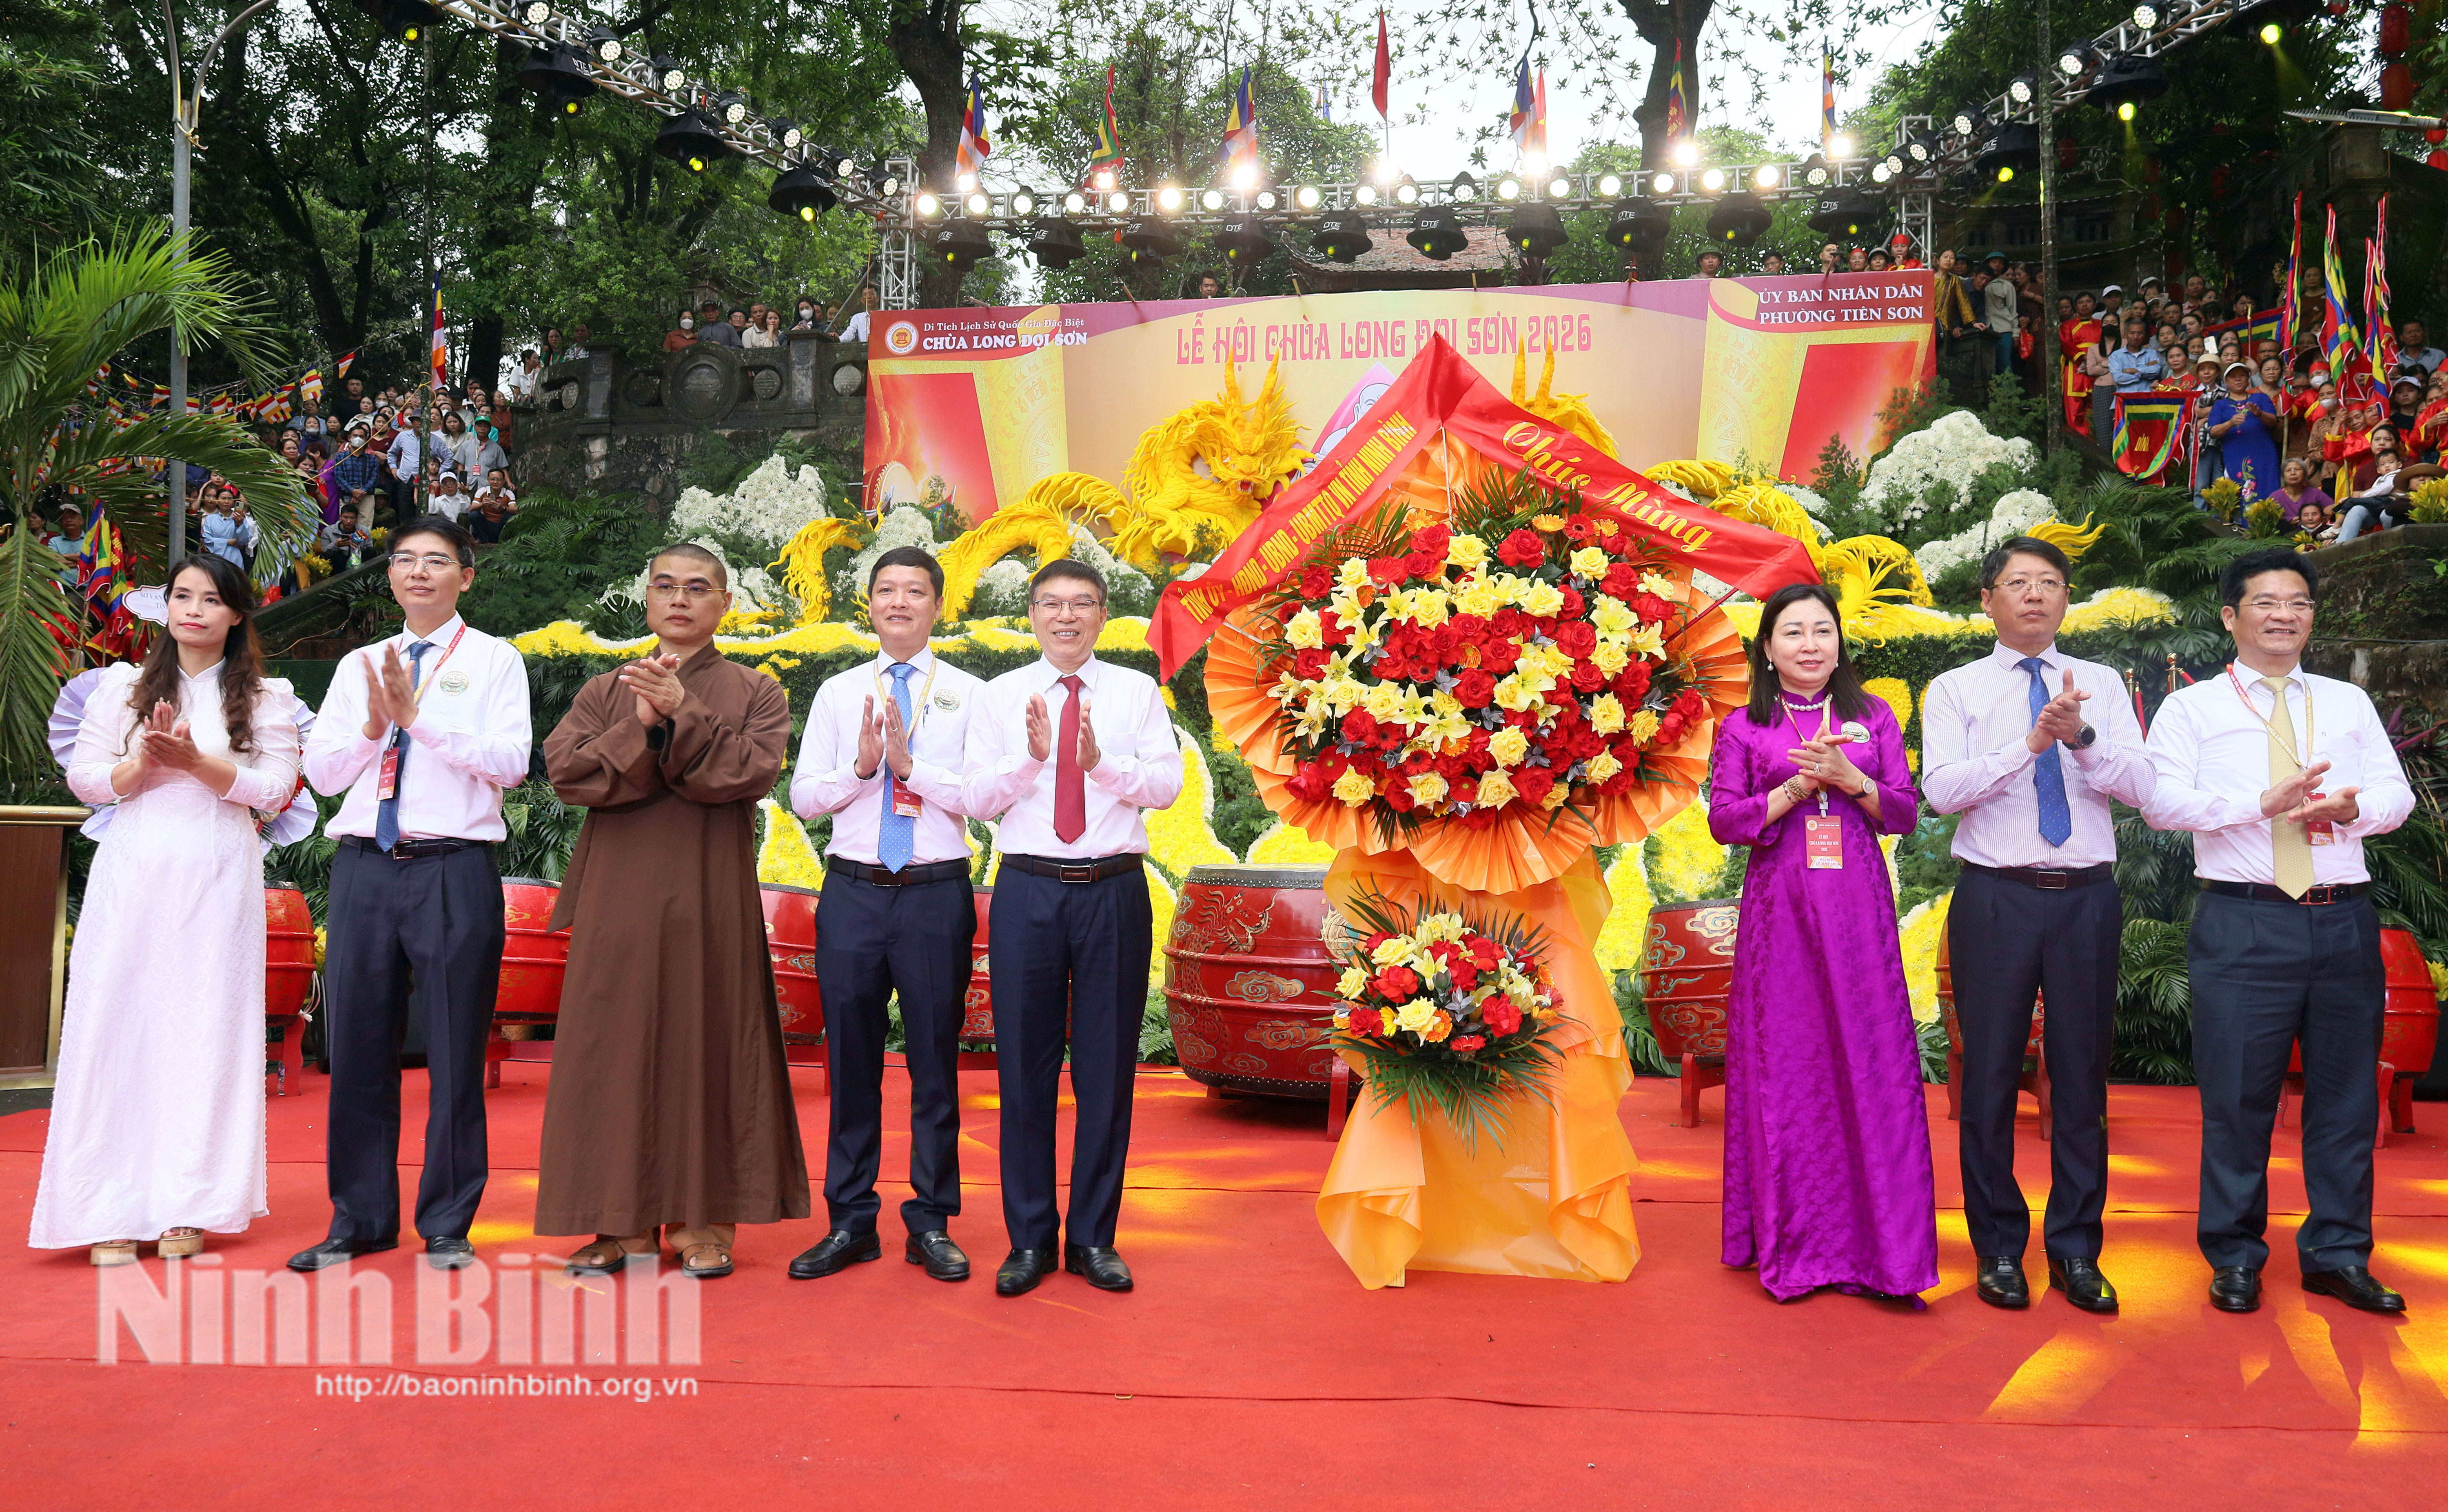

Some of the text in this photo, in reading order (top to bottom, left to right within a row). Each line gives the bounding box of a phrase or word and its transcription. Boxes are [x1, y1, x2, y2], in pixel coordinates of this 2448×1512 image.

[1226, 223, 1243, 231] DTE
[1618, 210, 1635, 219] DTE
[1758, 283, 1923, 304] ỦY BAN NHÂN DÂN
[924, 323, 934, 331] Di
[937, 321, 958, 331] Tích
[960, 321, 980, 332] Lịch
[983, 319, 996, 330] Sử
[998, 319, 1022, 331] Quốc
[1025, 319, 1041, 328] Gia
[1043, 318, 1062, 330] Đặc
[1064, 318, 1084, 328] Biệt
[1759, 305, 1923, 325] PHƯỜNG TIÊN SƠN
[922, 333, 968, 350] CHÙA
[972, 334, 1016, 349] LONG
[1019, 334, 1050, 350] ĐỌI
[1054, 330, 1087, 346] SƠN
[1176, 311, 1204, 365] LỄ
[1212, 317, 1256, 372] HỘI
[1265, 314, 1331, 362] CHÙA
[1340, 320, 1406, 359] LONG
[1467, 311, 1517, 355] SƠN
[1528, 313, 1591, 353] 2026
[1377, 410, 1417, 453] BÌNH
[1356, 436, 1396, 476] NINH
[1327, 477, 1357, 509] VN
[1335, 460, 1375, 496] TỈNH
[1503, 421, 1713, 553] Chúc Mừng
[1288, 490, 1345, 545] UBMTTQ
[1259, 529, 1299, 573] UBND
[1206, 581, 1226, 607] ỦY
[1231, 558, 1268, 597] HĐND
[1177, 587, 1214, 624] TỈNH
